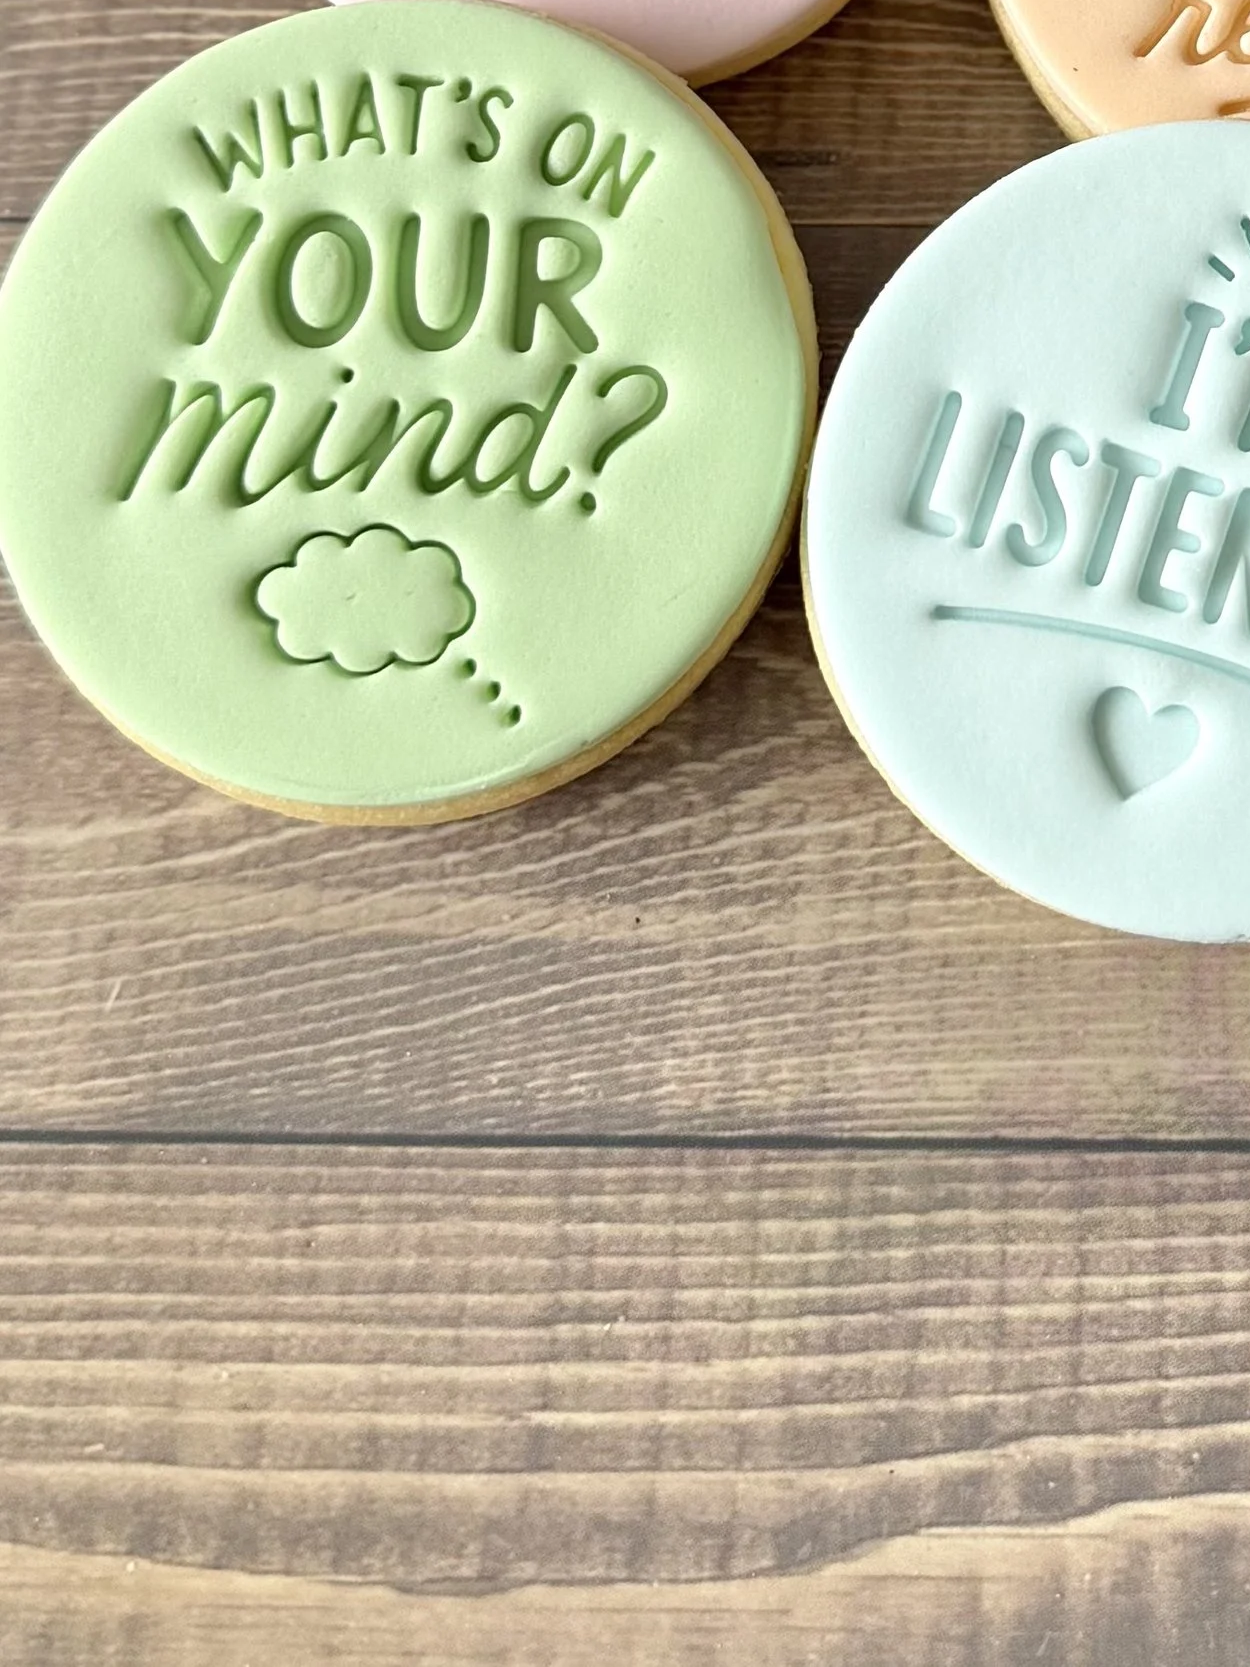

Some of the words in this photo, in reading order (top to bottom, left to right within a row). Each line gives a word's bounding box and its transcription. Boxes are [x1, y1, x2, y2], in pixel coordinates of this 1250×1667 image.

[193, 71, 513, 192] WHAT'S
[540, 111, 655, 218] ON
[168, 205, 603, 354] YOUR
[118, 363, 668, 516] mind?
